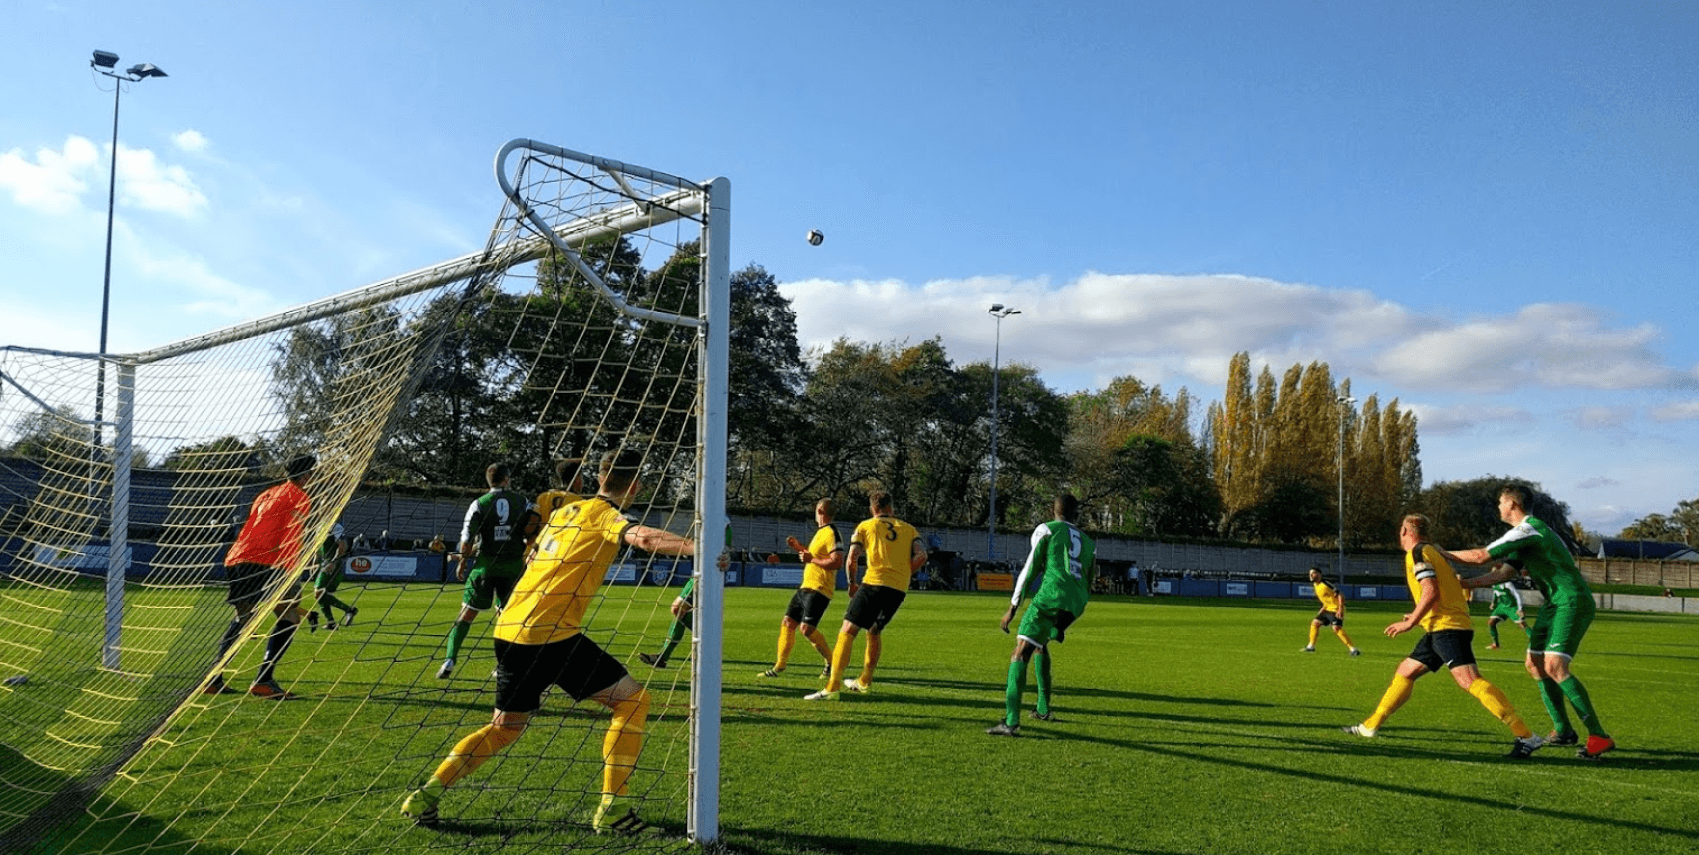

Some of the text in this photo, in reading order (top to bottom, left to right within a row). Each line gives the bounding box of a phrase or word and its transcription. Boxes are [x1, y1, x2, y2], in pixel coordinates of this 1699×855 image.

[496, 498, 509, 525] 9
[881, 520, 898, 541] 3
[1069, 527, 1081, 558] 5
